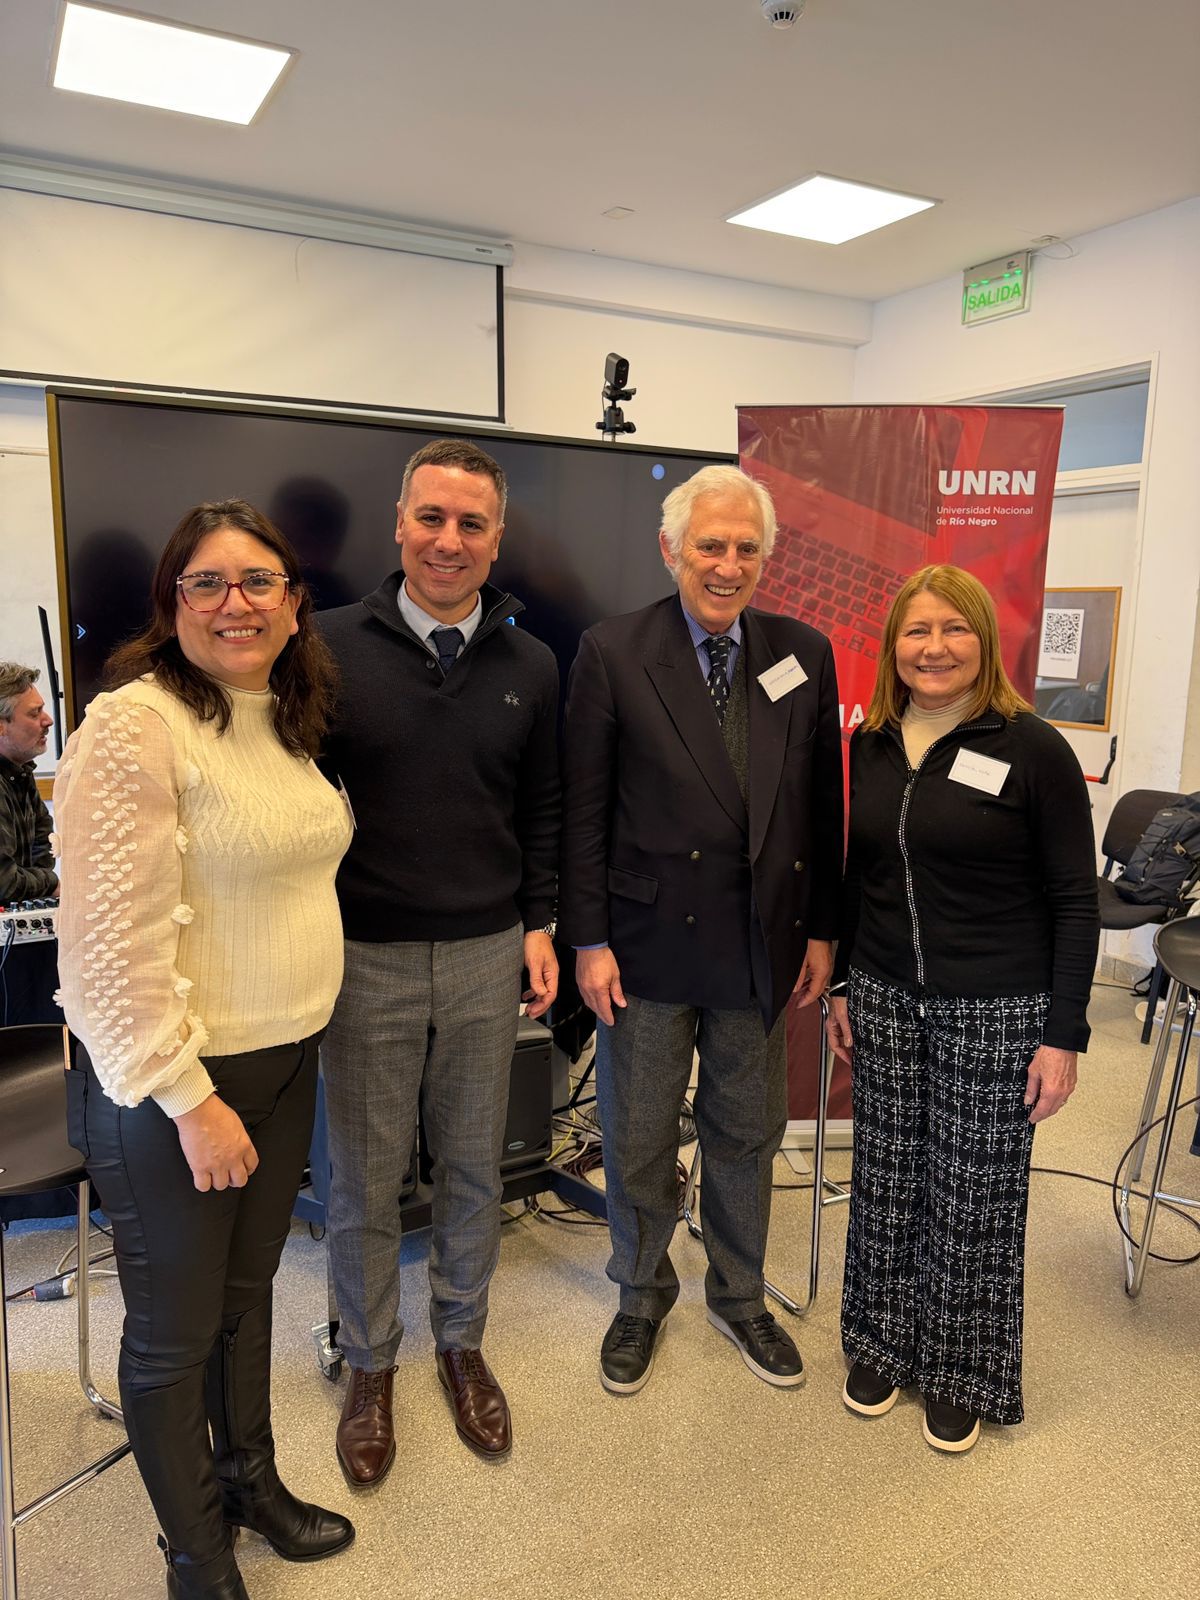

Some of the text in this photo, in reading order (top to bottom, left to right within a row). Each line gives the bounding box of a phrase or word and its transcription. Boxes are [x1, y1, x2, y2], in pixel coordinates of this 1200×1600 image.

[968, 282, 1022, 311] SALIDA
[938, 470, 1036, 495] UNRN
[936, 506, 1033, 514] Universidad Nacional
[936, 517, 997, 526] de Río Negro
